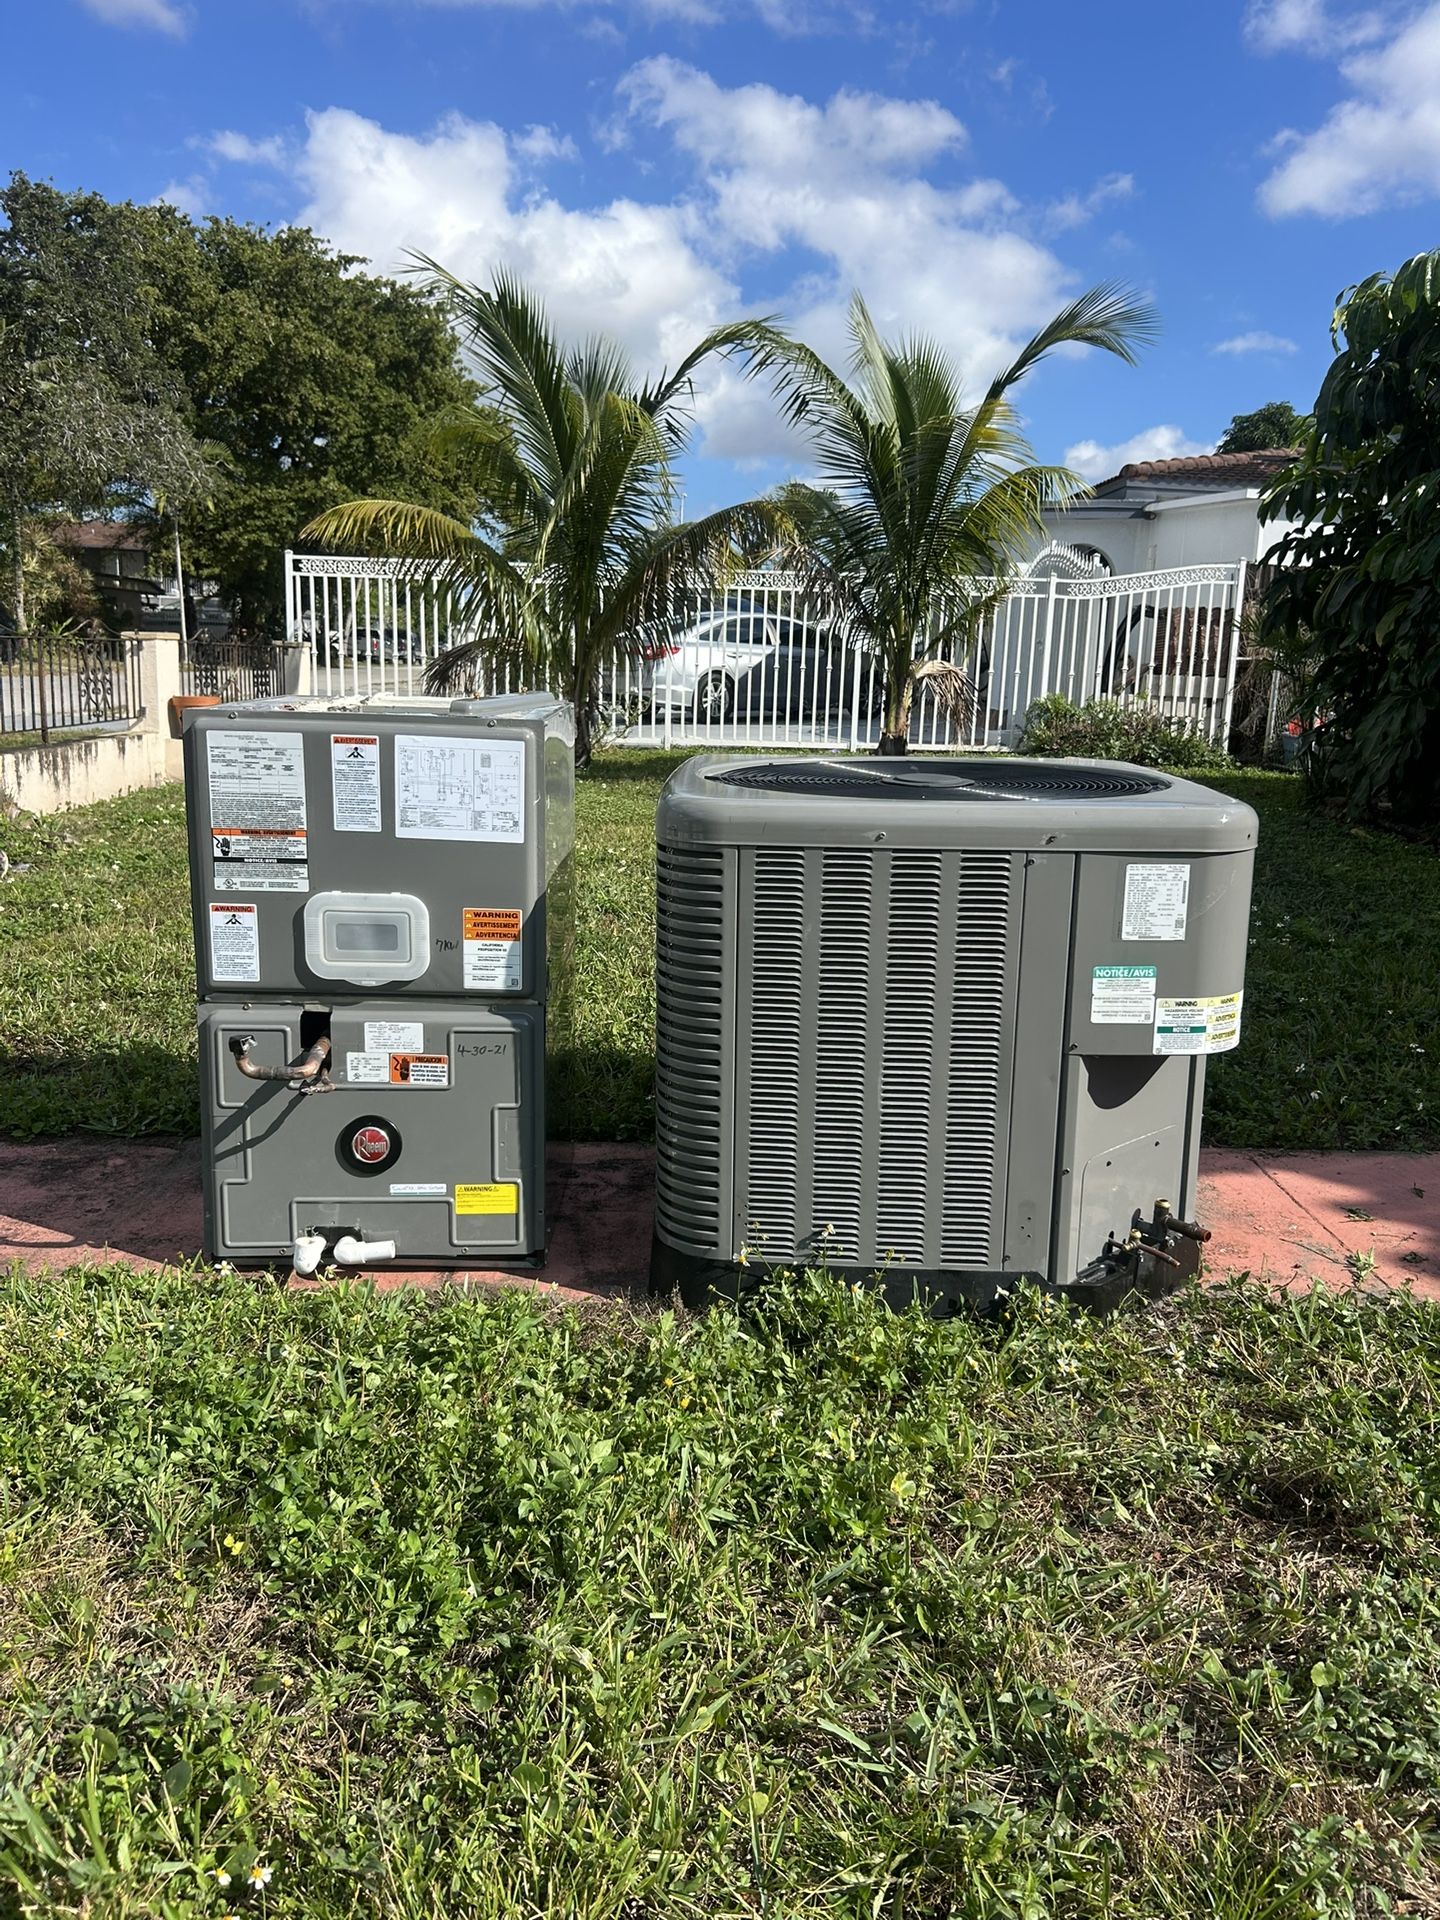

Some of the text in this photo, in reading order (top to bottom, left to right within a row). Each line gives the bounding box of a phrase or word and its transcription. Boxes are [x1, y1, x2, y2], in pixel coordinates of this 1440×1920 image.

[473, 911, 519, 919] WARNING
[475, 931, 517, 939] ADVERTENCIA
[1095, 968, 1154, 978] NOTICE/AVIS
[457, 1044, 507, 1057] 4-30-21
[357, 1131, 387, 1158] Rheem
